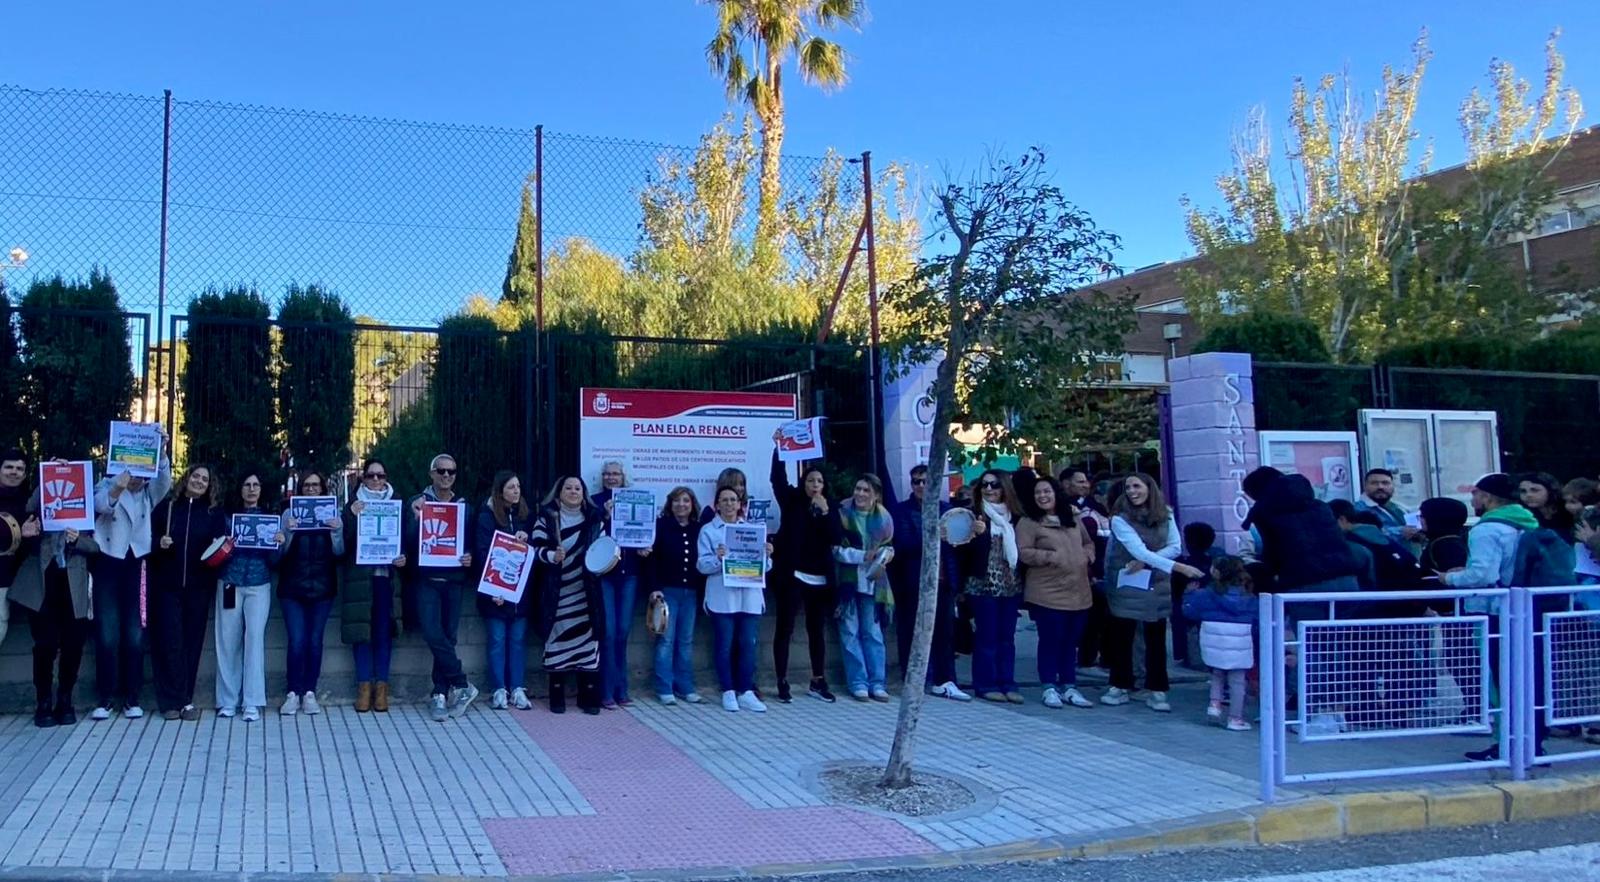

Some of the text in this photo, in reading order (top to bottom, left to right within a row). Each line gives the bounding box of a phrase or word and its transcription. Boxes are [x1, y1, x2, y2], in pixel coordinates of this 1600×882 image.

[632, 423, 746, 436] PLAN ELDA RENACE
[1223, 373, 1250, 521] SANTO
